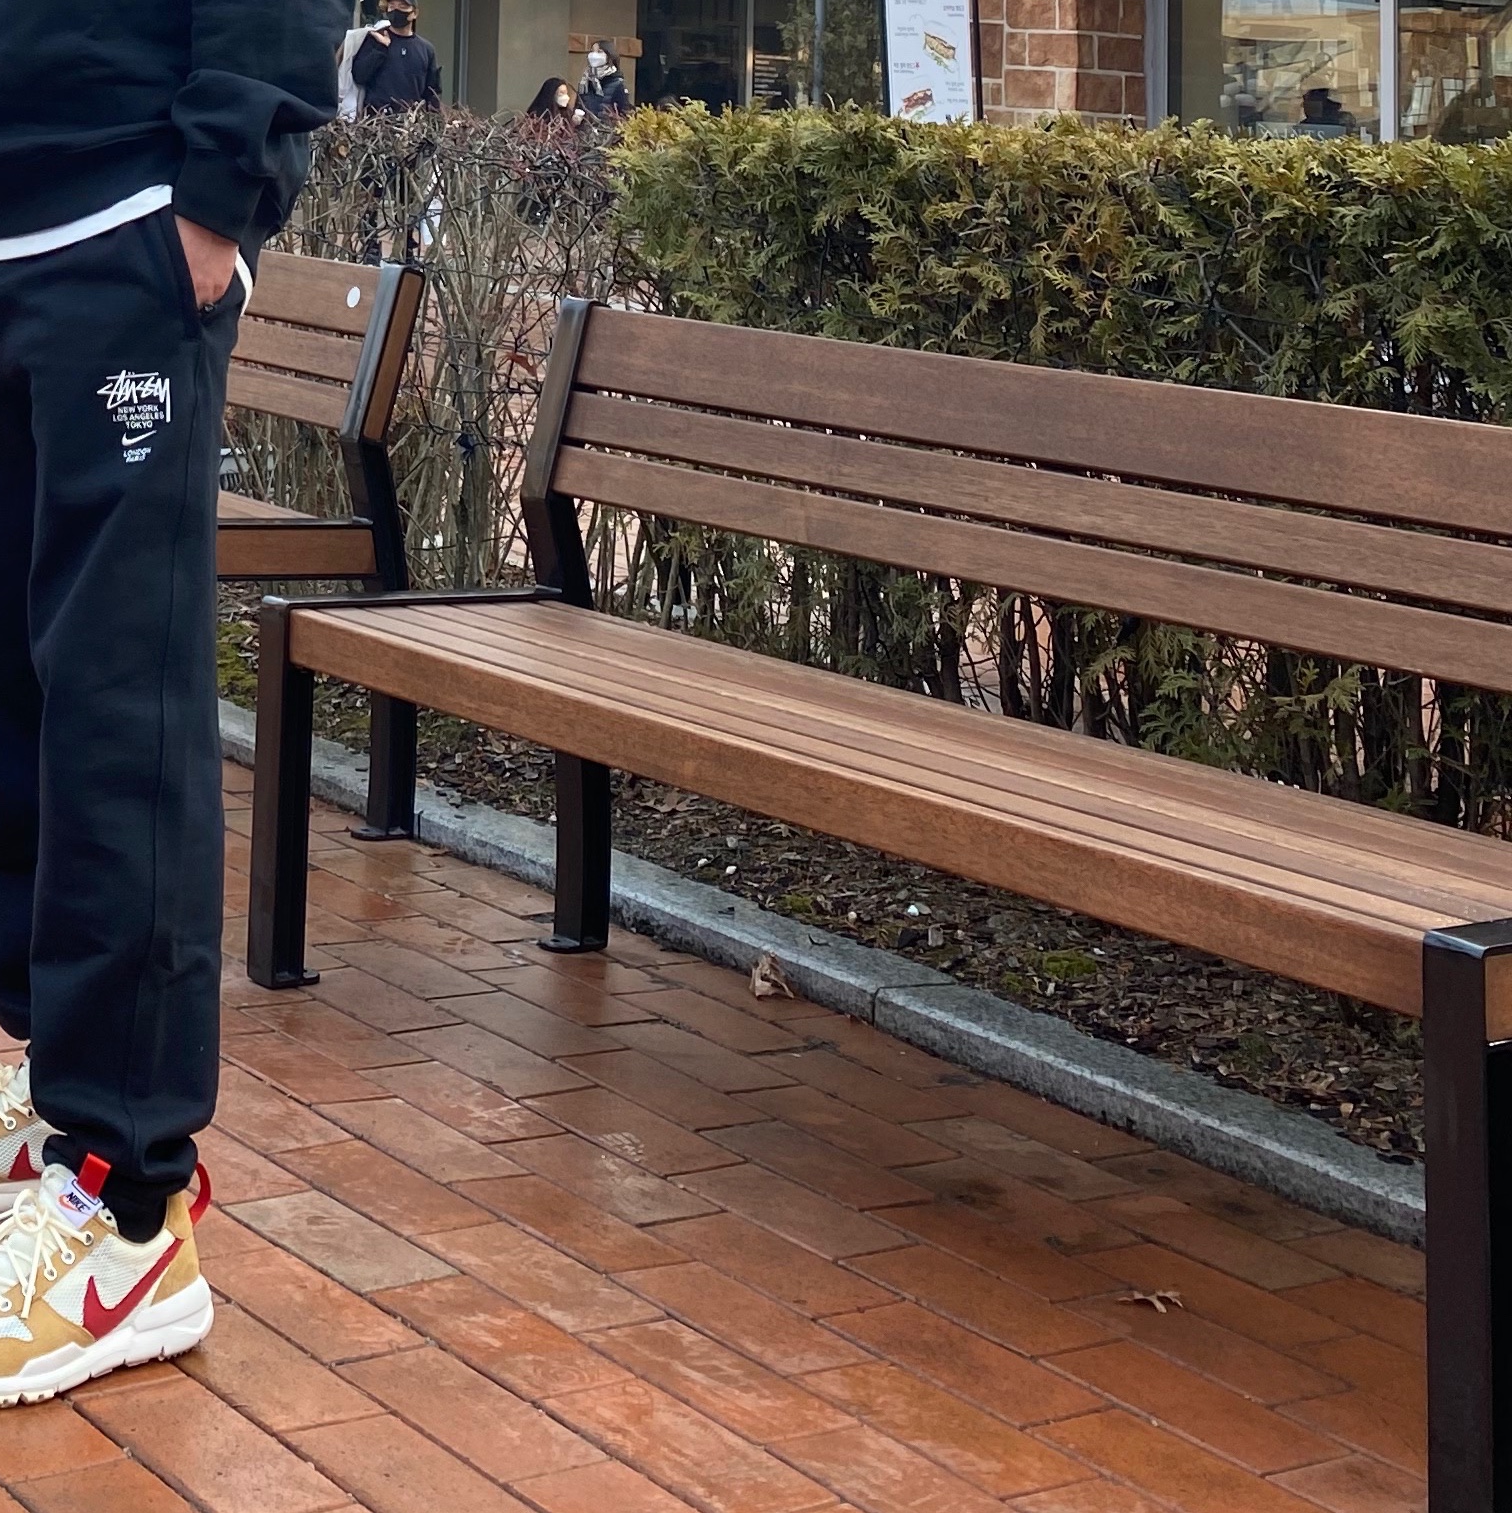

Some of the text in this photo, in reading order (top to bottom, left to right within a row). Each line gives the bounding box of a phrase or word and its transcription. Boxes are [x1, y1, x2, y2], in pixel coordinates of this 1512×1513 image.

[118, 404, 159, 414] NEW YORK
[112, 411, 165, 422] LOS ANGELES
[125, 420, 153, 429] TOKYO
[66, 1191, 91, 1213] NIKE
